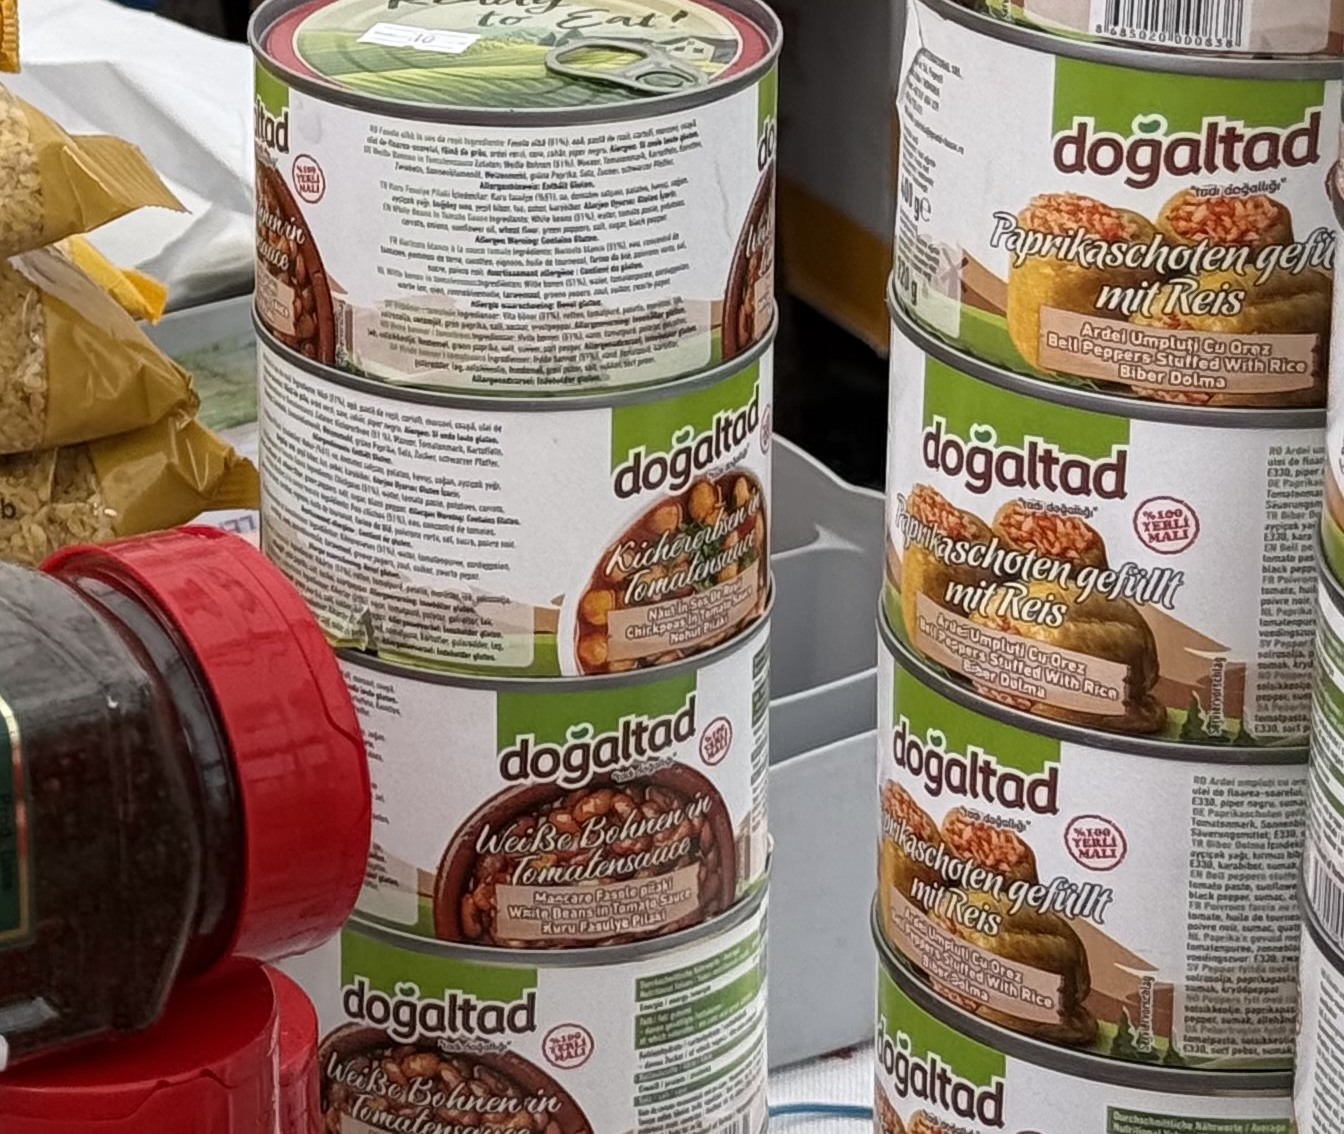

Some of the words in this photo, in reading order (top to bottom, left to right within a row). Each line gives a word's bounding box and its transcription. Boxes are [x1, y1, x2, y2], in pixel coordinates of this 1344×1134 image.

[475, 9, 523, 28] to
[555, 5, 689, 32] Eat!
[1052, 110, 1322, 190] doğaltad
[990, 211, 1251, 278] Paprikaschoten
[1254, 230, 1337, 286] gefü
[1095, 279, 1163, 315] mit
[1164, 278, 1246, 318] Reis
[1047, 333, 1080, 354] Bell
[1081, 340, 1152, 366] Peppers
[1155, 351, 1219, 371] Stuffed
[1223, 354, 1266, 374] With
[1269, 357, 1308, 374] Rice
[1119, 364, 1165, 385] Biber
[1170, 371, 1227, 390] Dolma
[613, 389, 761, 498] doğaltad
[923, 420, 1128, 501] doğaltad
[1146, 527, 1190, 544] MALI
[945, 577, 993, 616] mit
[996, 580, 1069, 629] Reis
[1076, 561, 1186, 611] gefüllt
[499, 697, 696, 783] doğaltad
[892, 719, 1060, 816] doğaltad
[475, 823, 578, 857] Weiße
[579, 808, 685, 850] Bohnen
[687, 791, 714, 819] in
[510, 836, 691, 887] Tomatensauce
[656, 887, 692, 910] Sauce
[1007, 875, 1114, 926] gefüllt
[342, 980, 537, 1038] doğaltad
[325, 1051, 411, 1103] Weiße
[409, 1077, 520, 1113] Bohnen
[524, 1090, 561, 1113] in
